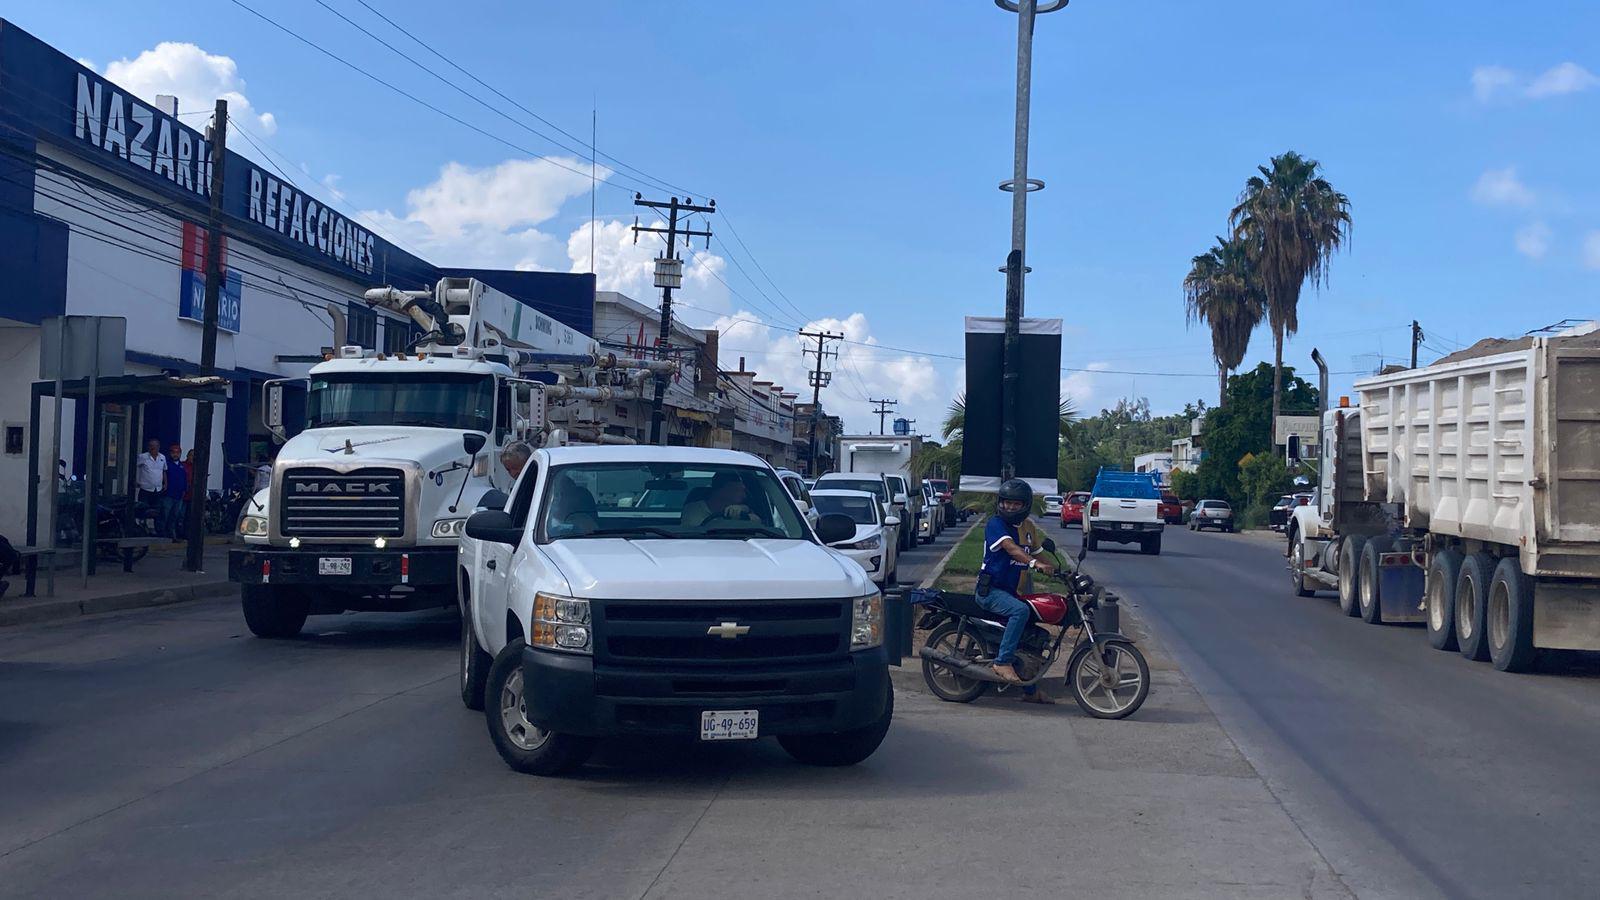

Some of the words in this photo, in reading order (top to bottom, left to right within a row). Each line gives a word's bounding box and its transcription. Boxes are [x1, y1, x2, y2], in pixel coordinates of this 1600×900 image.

[250, 168, 375, 276] REFACCIONES
[295, 482, 391, 493] MACK
[703, 718, 756, 731] UG-49-659
